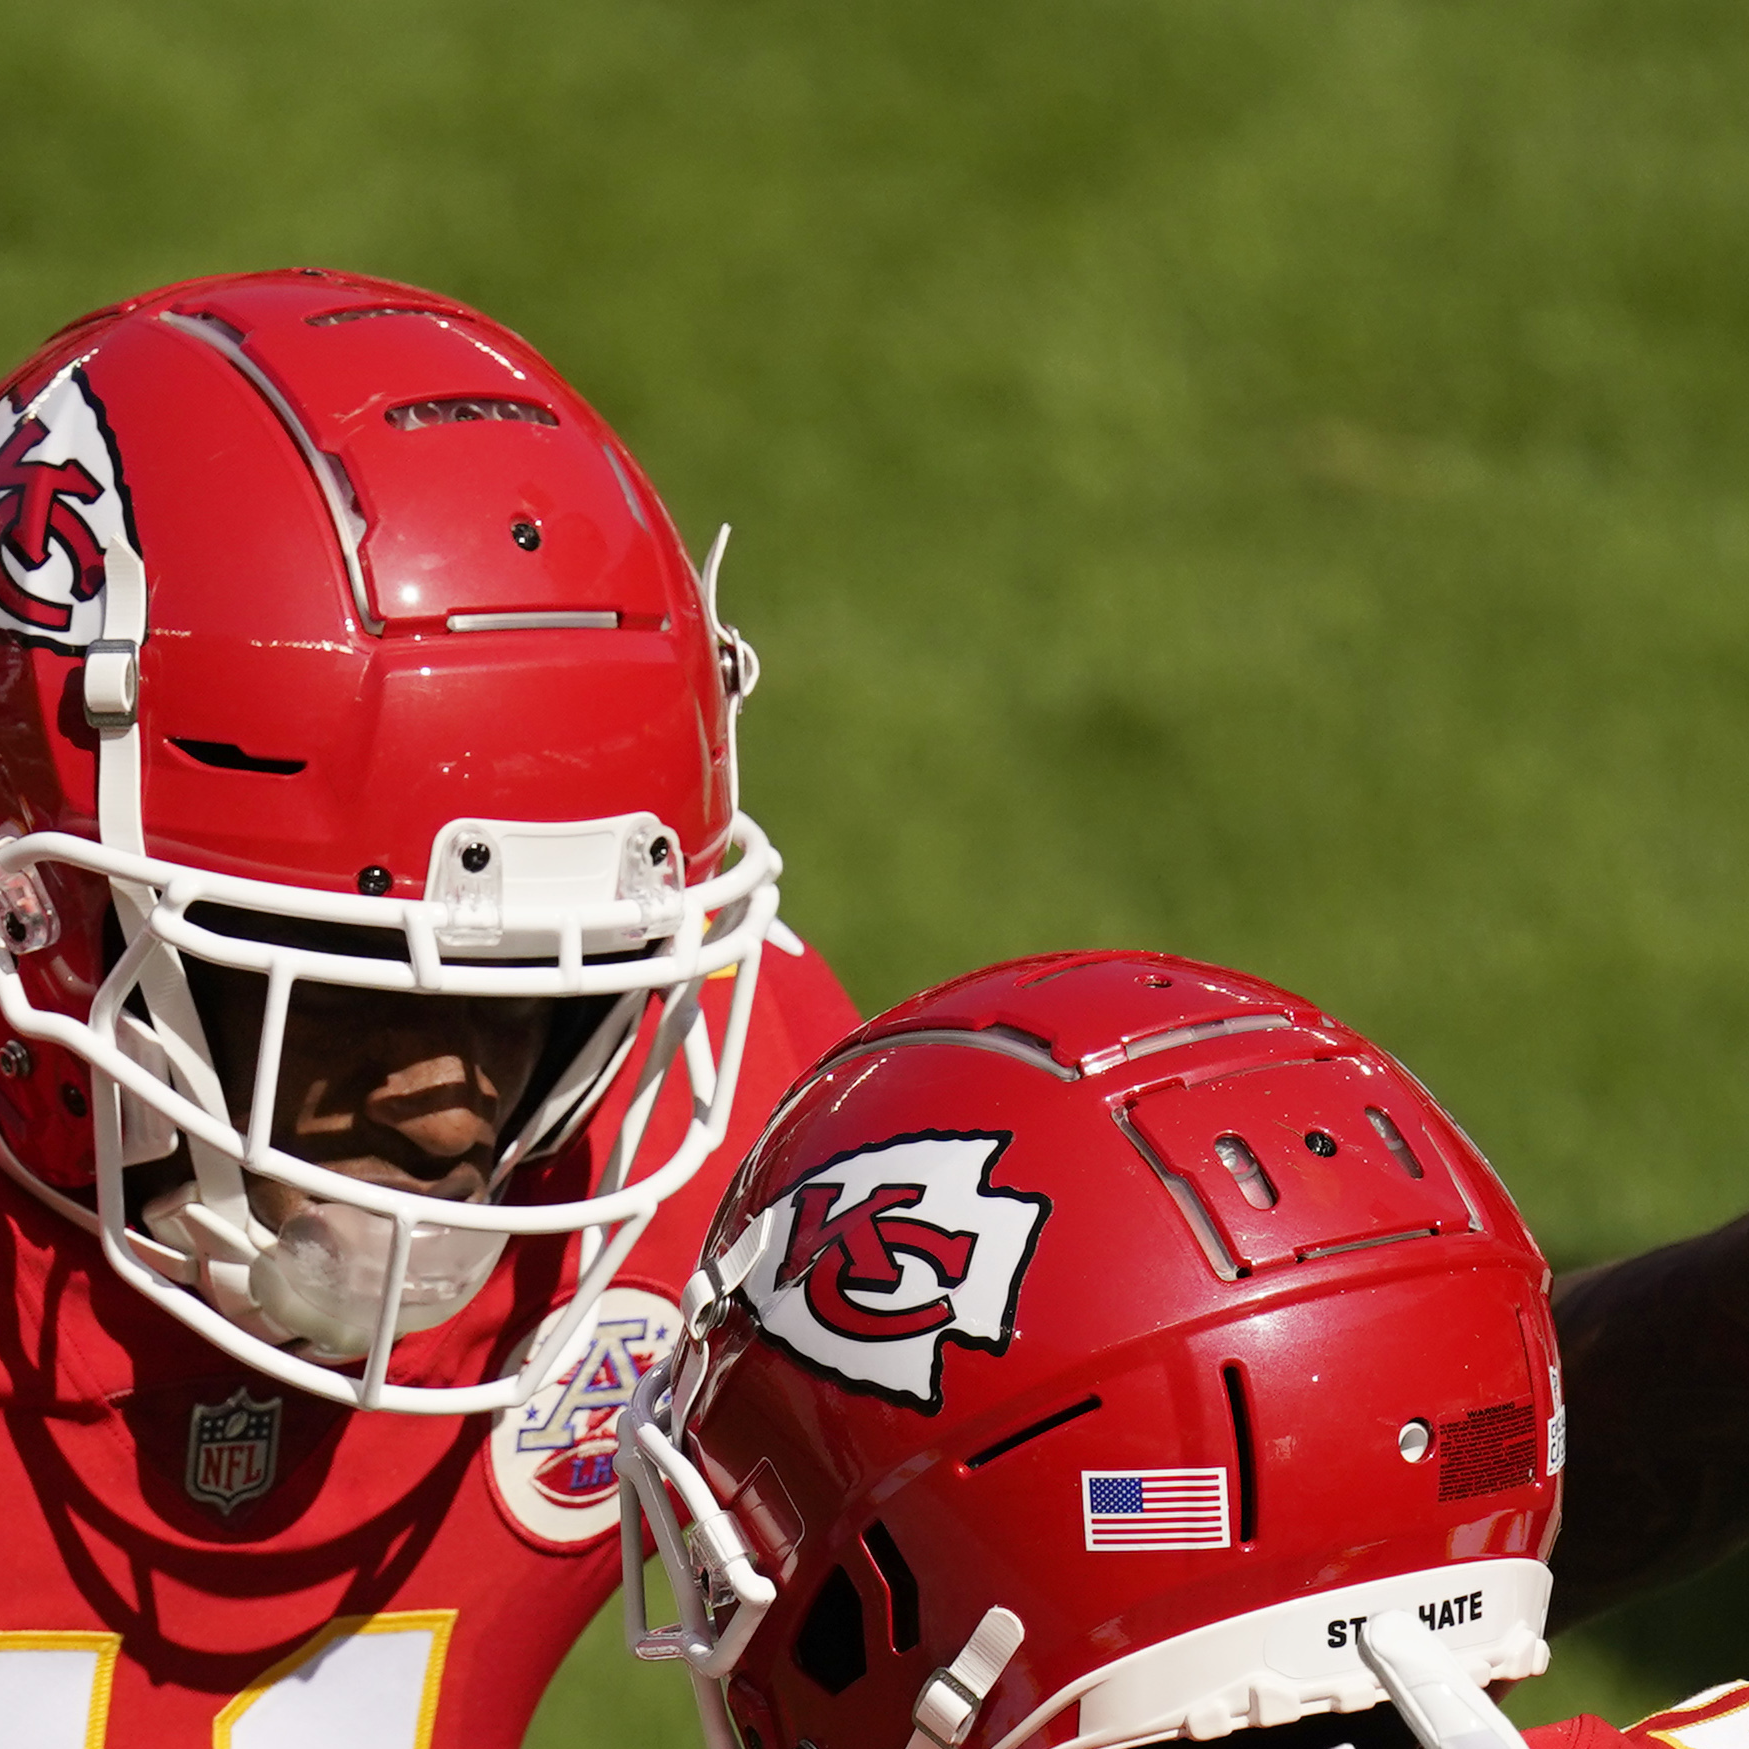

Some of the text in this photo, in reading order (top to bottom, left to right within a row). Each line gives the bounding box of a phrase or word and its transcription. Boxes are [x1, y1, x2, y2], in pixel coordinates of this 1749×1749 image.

[773, 1182, 980, 1343] KC
[1466, 1401, 1516, 1419] WARNING
[200, 1443, 262, 1492] NFL
[1327, 1590, 1483, 1649] ST HATE
